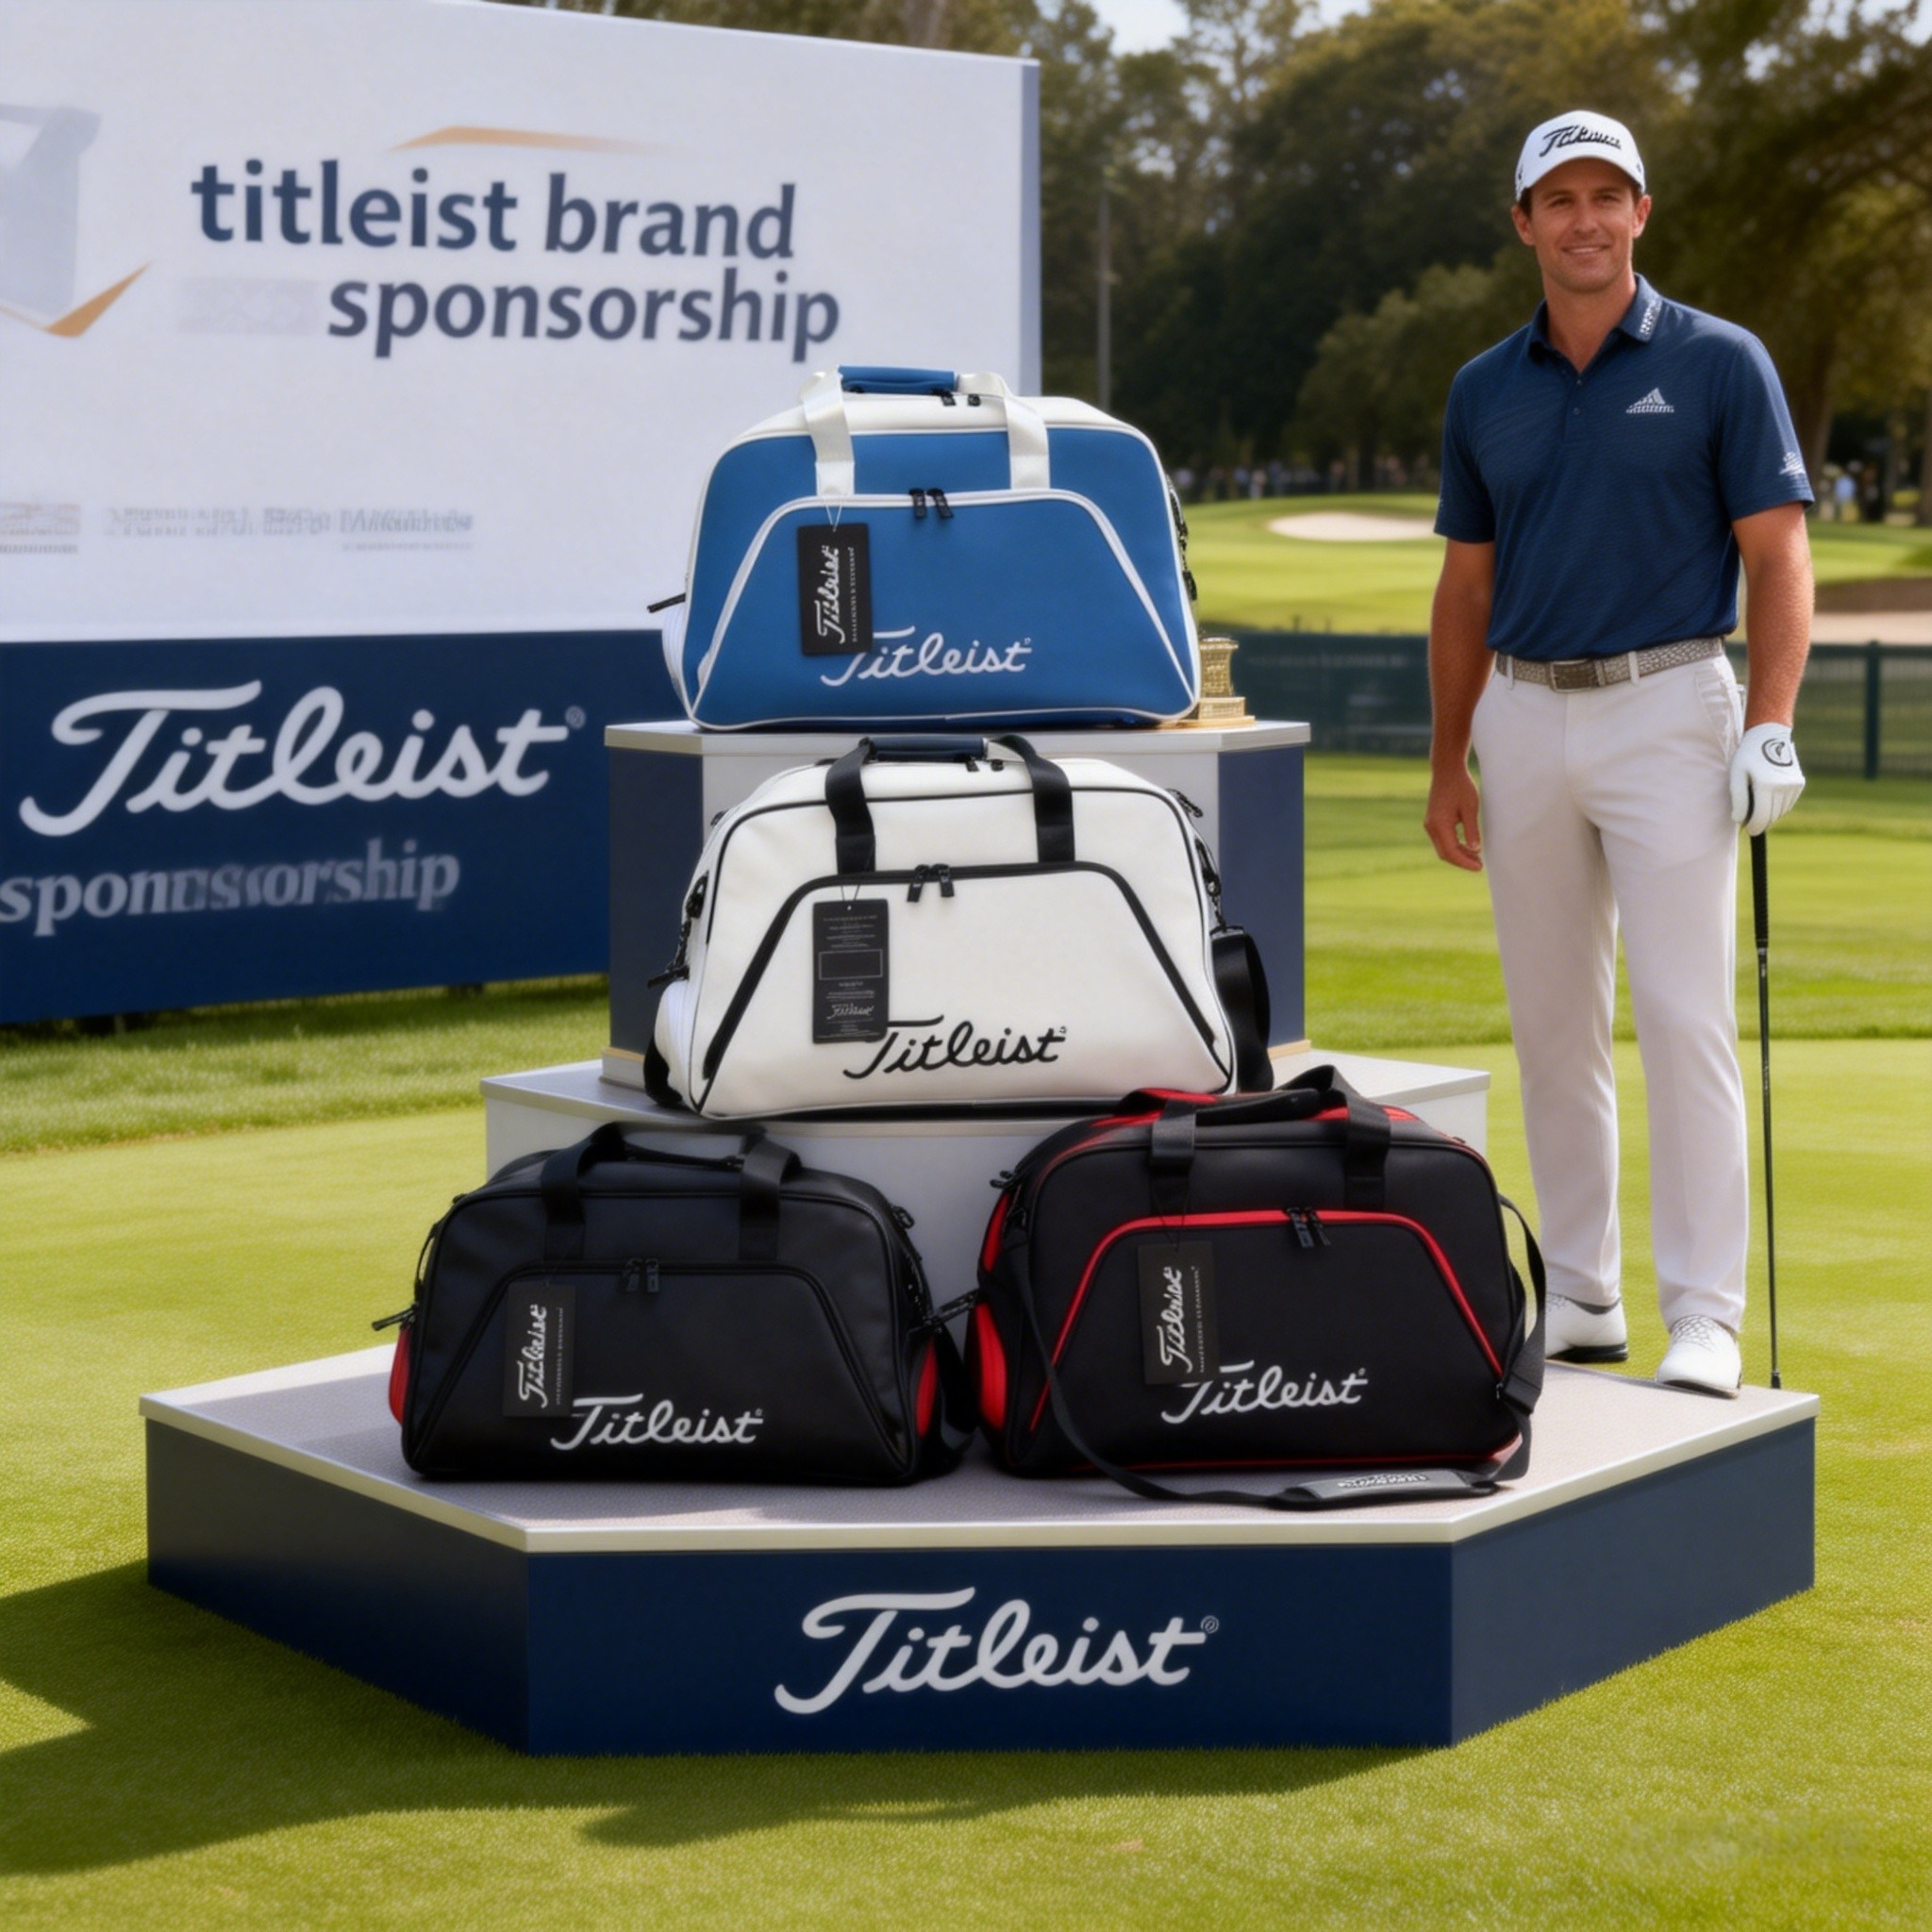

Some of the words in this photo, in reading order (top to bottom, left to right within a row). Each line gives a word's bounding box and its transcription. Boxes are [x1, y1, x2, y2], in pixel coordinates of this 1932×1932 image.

[191, 159, 518, 252] titleist
[543, 172, 796, 259] brand
[327, 266, 841, 363] sponsorship
[19, 679, 569, 837] Titleist
[774, 1586, 1208, 1715] Titleist
